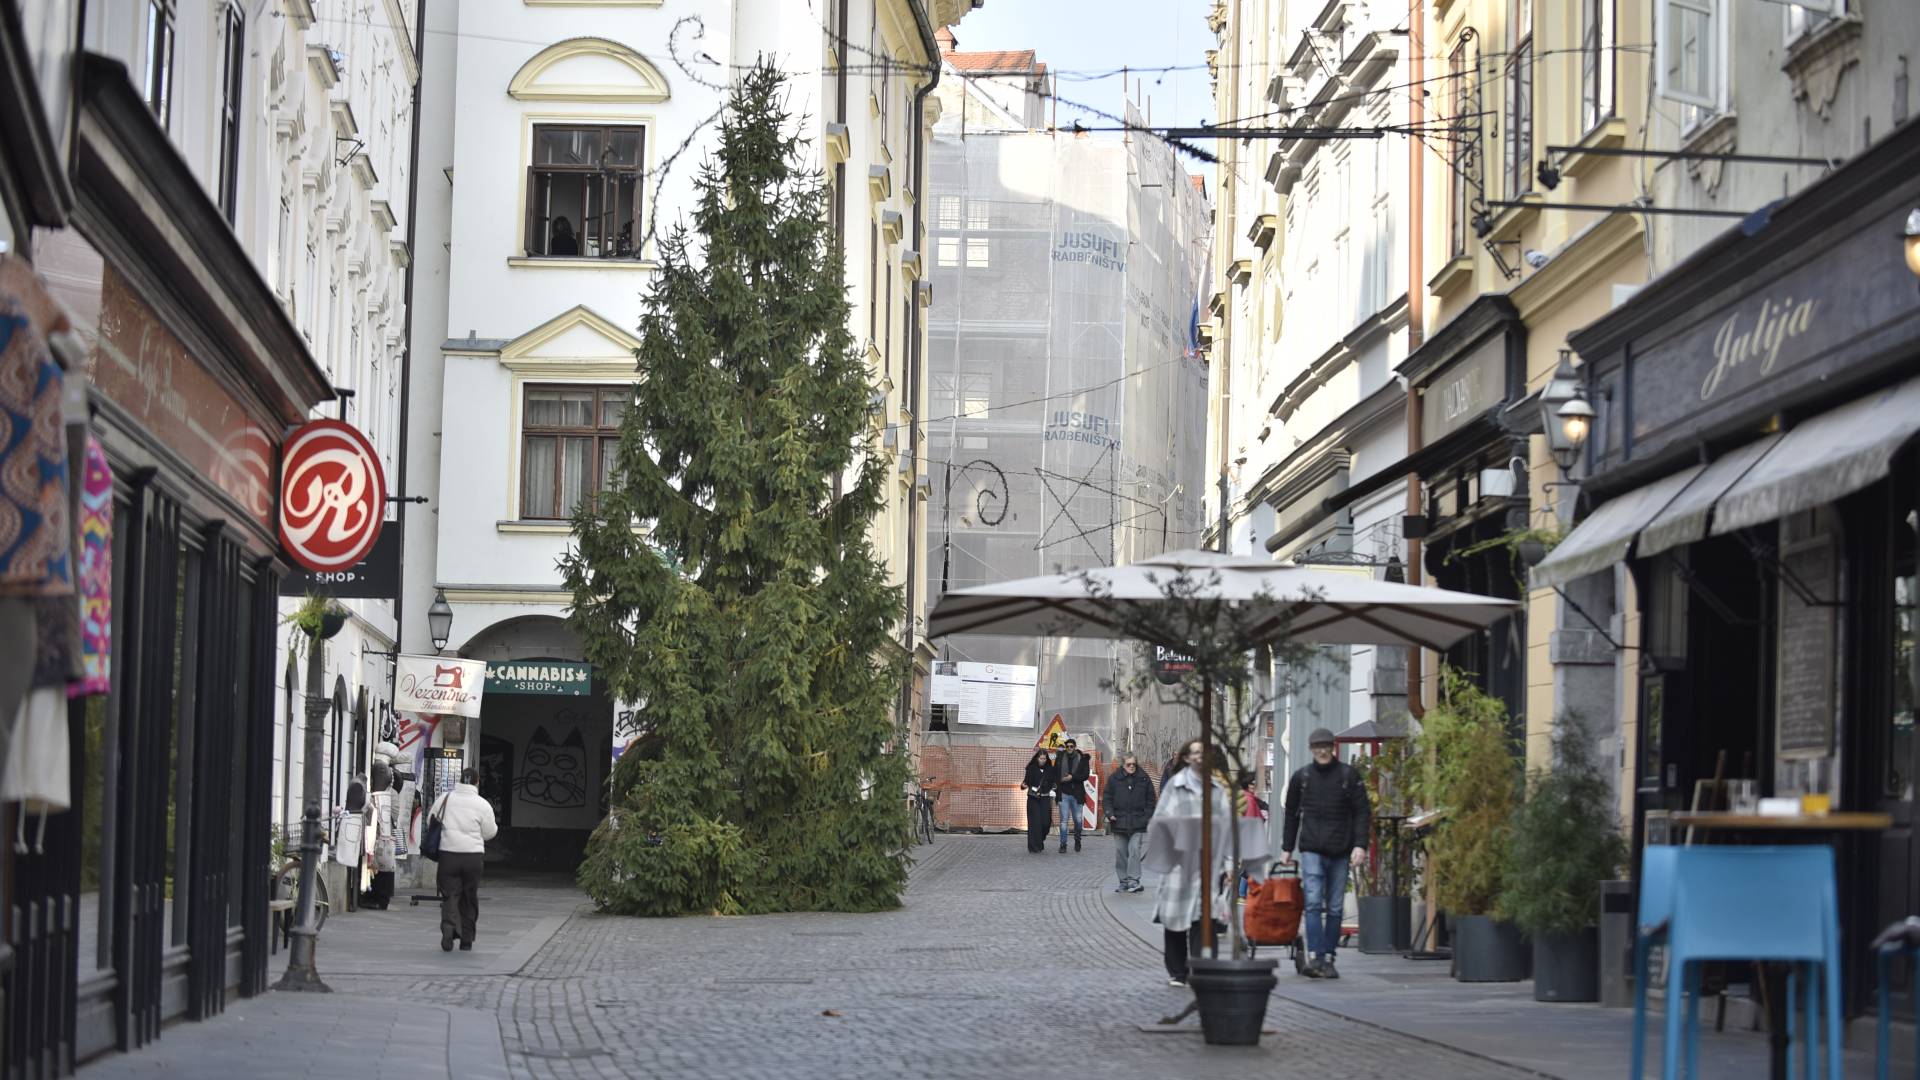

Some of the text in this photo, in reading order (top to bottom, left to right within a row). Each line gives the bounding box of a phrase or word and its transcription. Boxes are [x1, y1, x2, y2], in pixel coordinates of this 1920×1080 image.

[1058, 231, 1118, 258] JUSUFI
[1051, 250, 1127, 273] RADBENIŠTV
[1701, 296, 1818, 400] Julija
[1048, 411, 1109, 435] JUSUFI
[315, 572, 356, 582] SHOP
[496, 665, 576, 682] CANNABIS
[400, 673, 477, 703] Vezenina
[519, 682, 551, 691] SHOP
